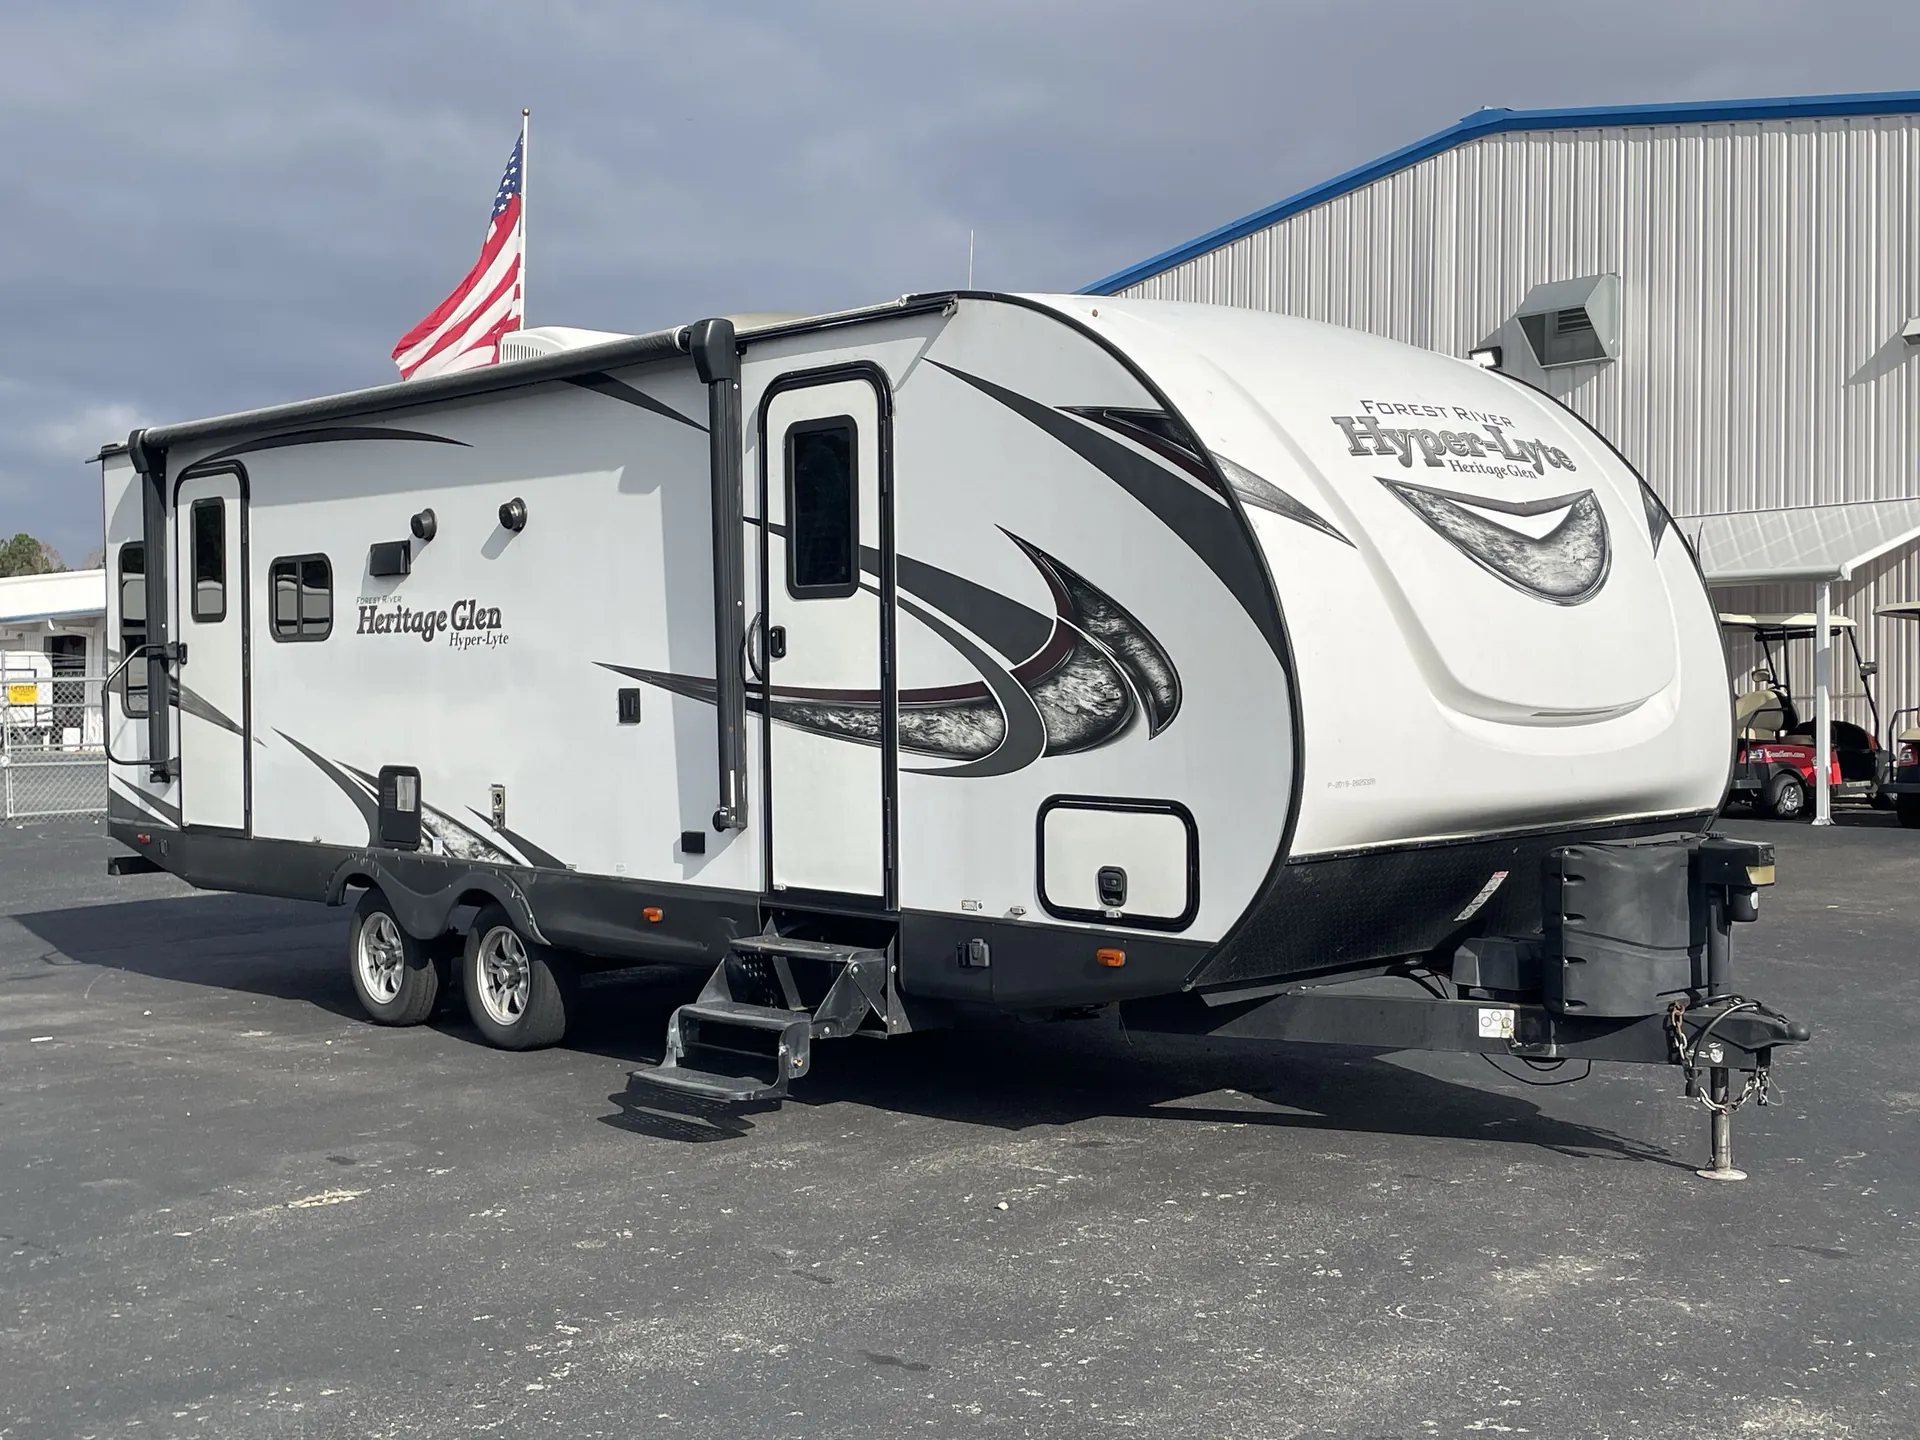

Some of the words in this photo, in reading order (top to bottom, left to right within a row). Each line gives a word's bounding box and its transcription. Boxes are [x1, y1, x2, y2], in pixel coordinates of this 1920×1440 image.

[1360, 400, 1448, 418] FOREST
[1452, 406, 1516, 429] RIVER
[1331, 415, 1577, 476] Hyper-Lyte
[1449, 459, 1508, 479] Heritage
[1508, 464, 1538, 479] Glen
[356, 605, 448, 642] Heritage
[451, 599, 502, 631] Glen
[449, 631, 509, 650] Hyper-Lyte
